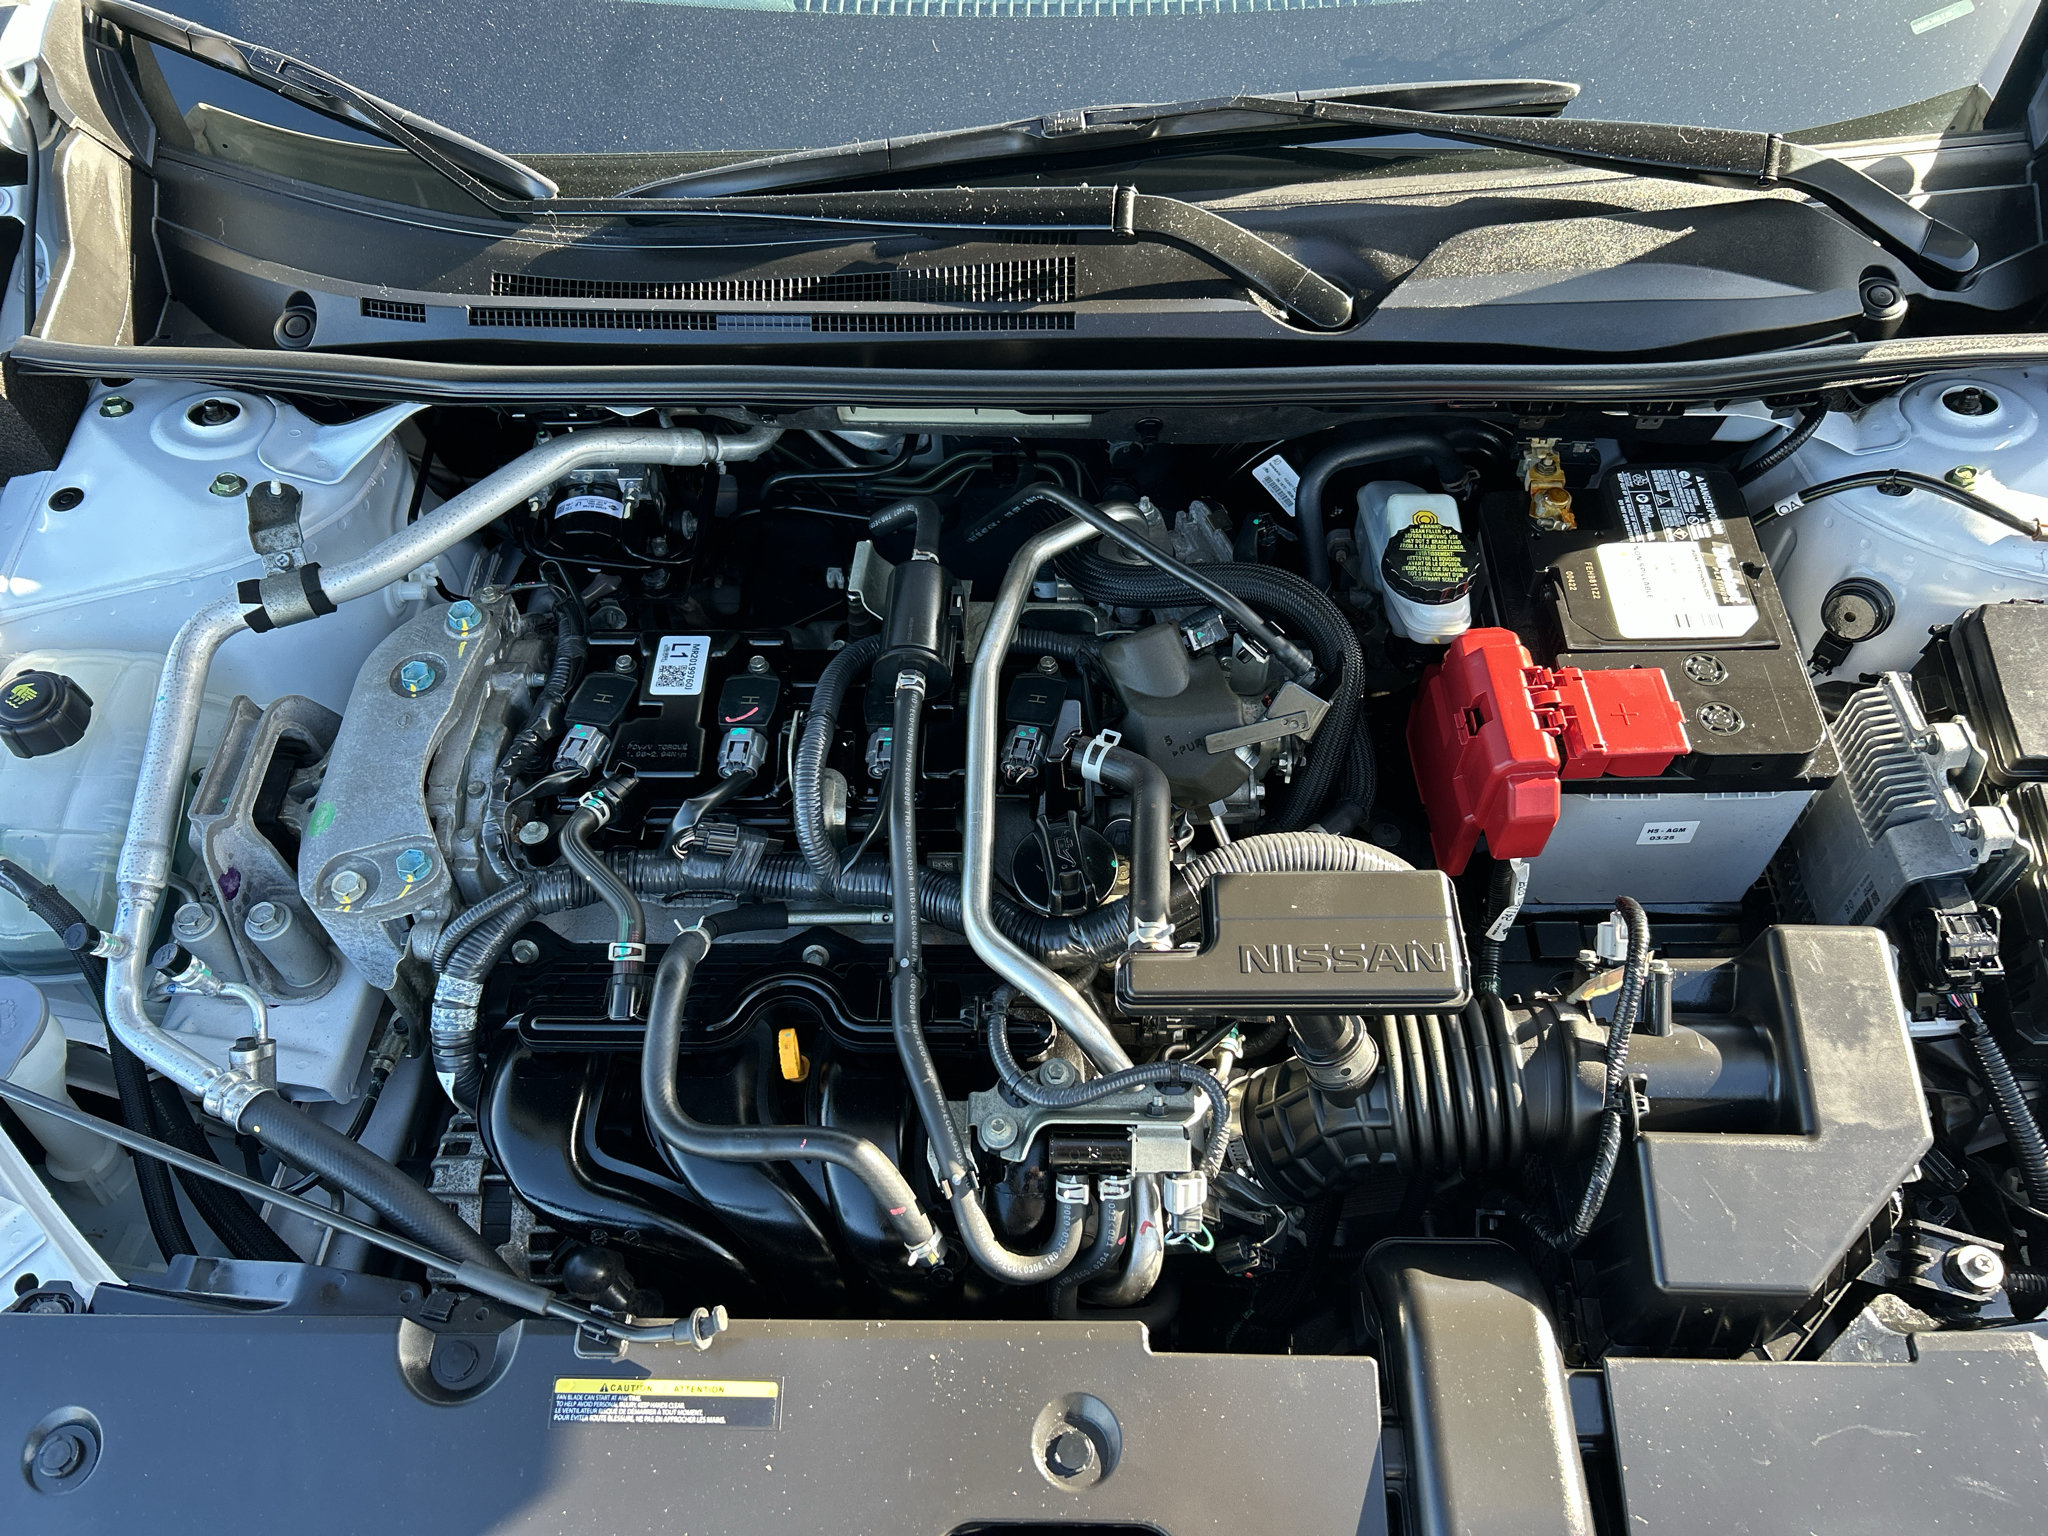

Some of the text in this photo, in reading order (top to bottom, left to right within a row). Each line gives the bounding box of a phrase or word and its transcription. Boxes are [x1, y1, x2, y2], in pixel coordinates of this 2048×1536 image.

[1615, 471, 1624, 483] KEEP
[1618, 481, 1626, 491] OUT
[1616, 498, 1624, 506] DO
[1618, 504, 1627, 514] NOT
[1625, 502, 1634, 516] REACH
[1644, 503, 1654, 519] READ
[1621, 512, 1630, 525] OPEN
[1639, 562, 1653, 599] SPILLABLE
[669, 643, 691, 658] L1
[1239, 943, 1447, 974] NISSAN
[610, 1384, 725, 1393] CAUTION ATTENTION
[593, 1400, 617, 1408] PERSONAL
[553, 1413, 569, 1421] POUR
[588, 1414, 607, 1422] TOUTE
[643, 1415, 654, 1423] PAS
[654, 1415, 662, 1423] EN
[662, 1415, 697, 1423] APPROCHER
